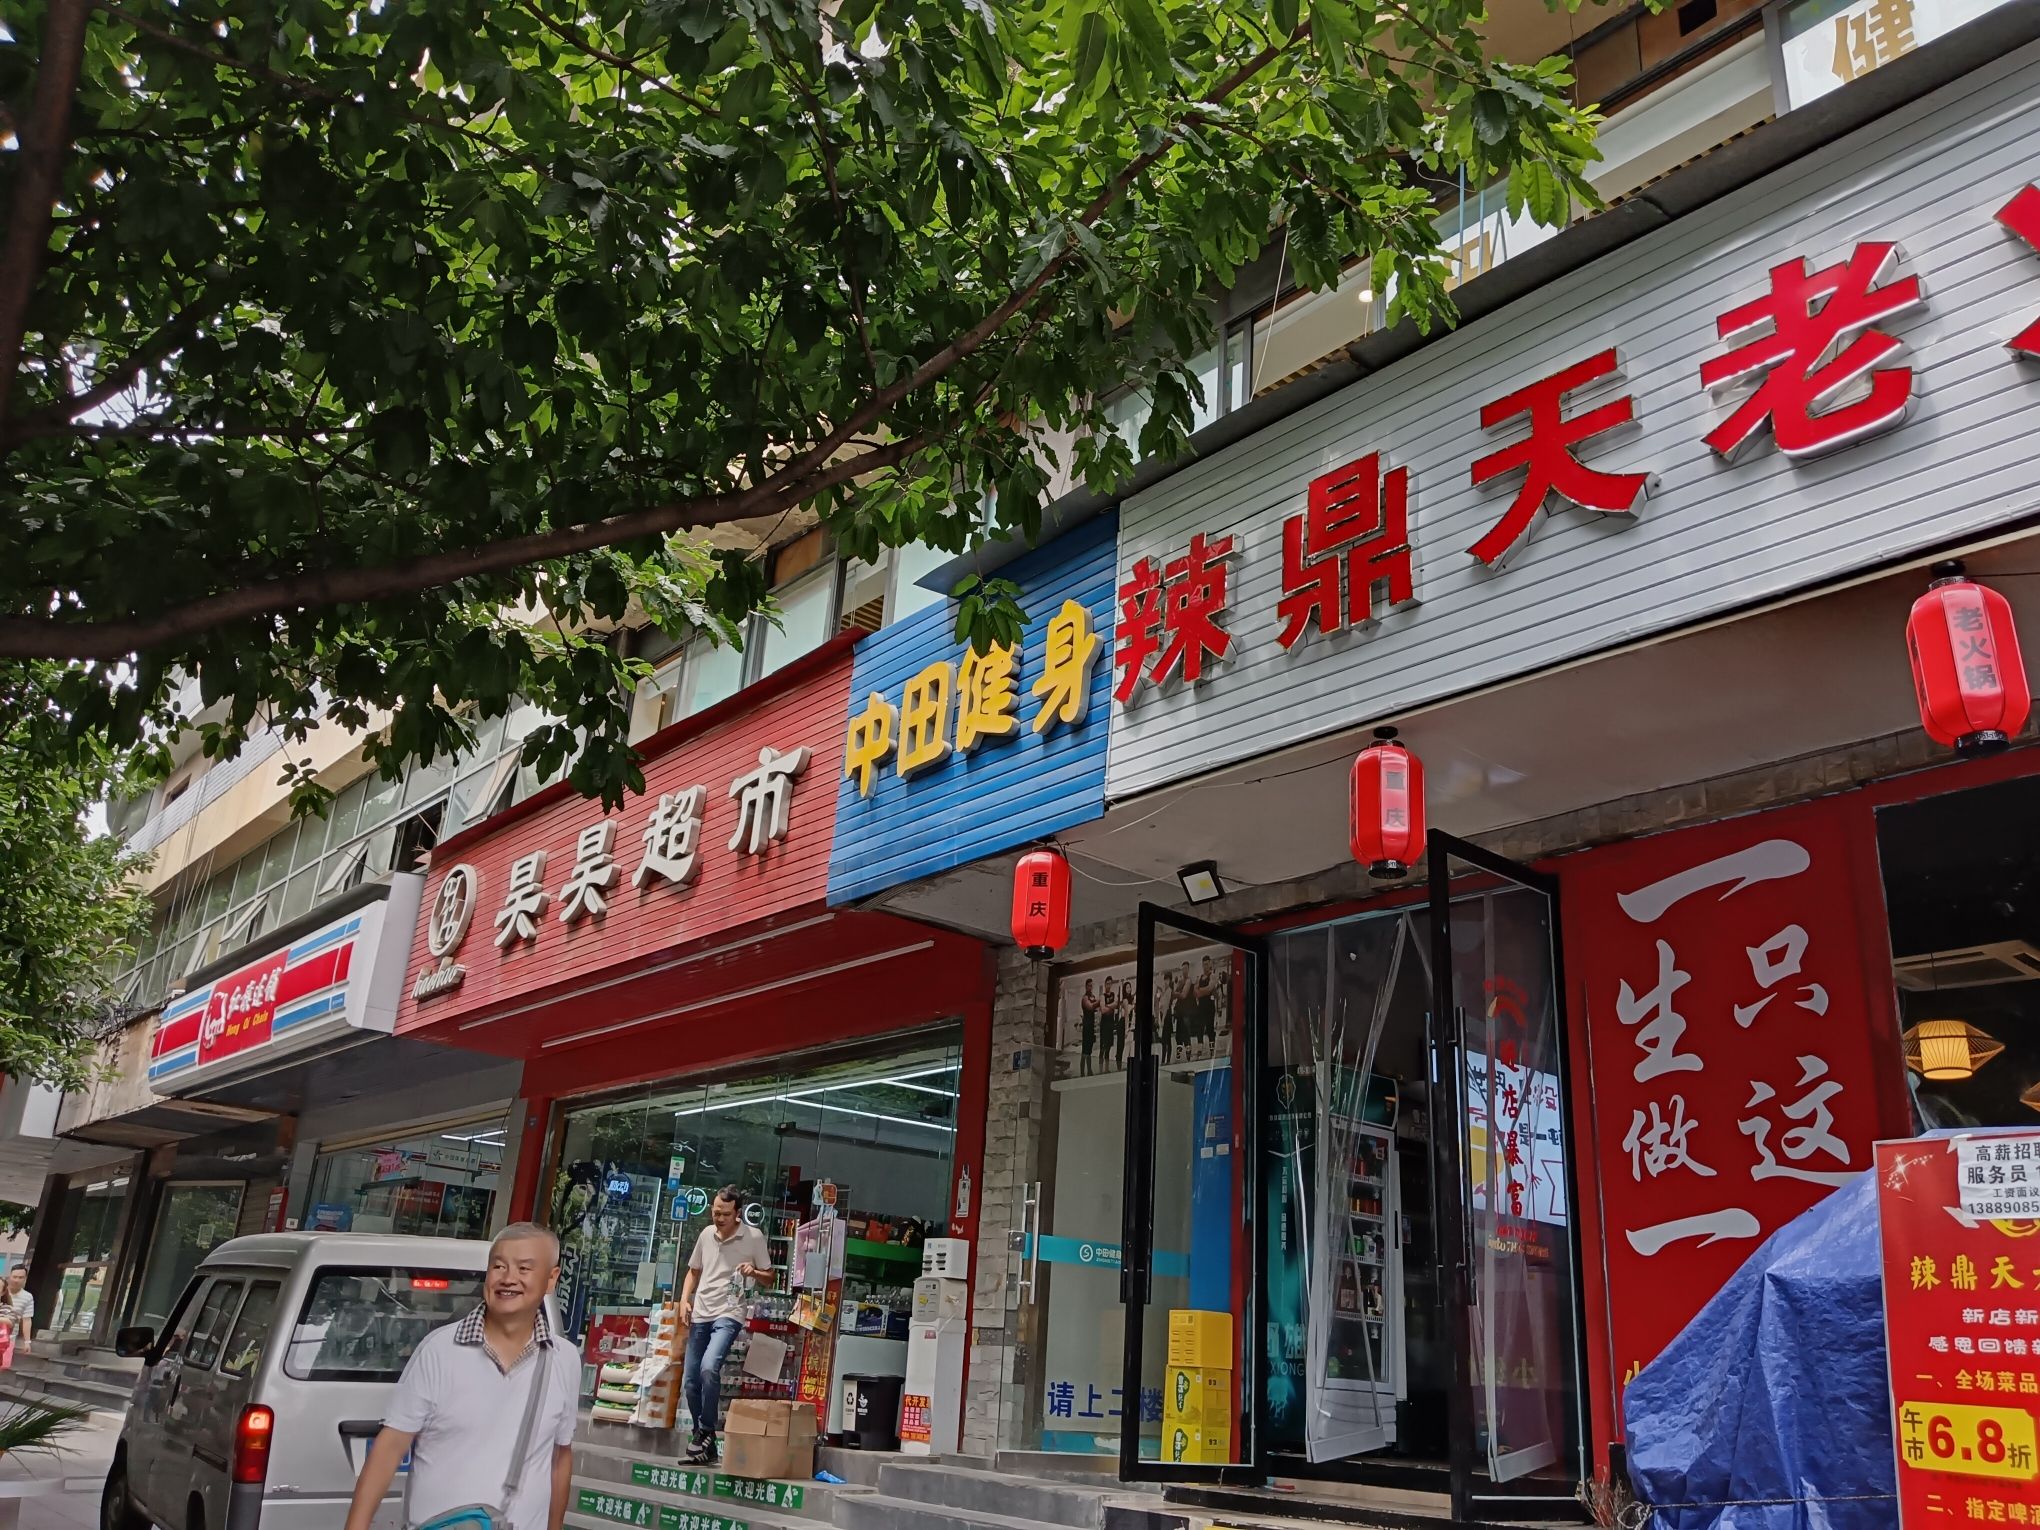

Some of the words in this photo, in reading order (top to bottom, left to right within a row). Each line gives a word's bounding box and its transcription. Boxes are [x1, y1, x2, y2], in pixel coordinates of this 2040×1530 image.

[1113, 183, 2040, 703] 辣鼎天老
[1953, 606, 1999, 690] 老火锅
[844, 597, 1105, 800] 中田健身
[493, 745, 813, 949] 昊昊超市
[1029, 871, 1049, 917] 重庆
[1967, 1165, 2027, 1184] 服务员
[1992, 1187, 2040, 1198] 工资面议
[905, 1396, 929, 1408] 代开发
[1903, 1408, 1925, 1461] 午市
[650, 1468, 688, 1491] 欢迎光临
[733, 1479, 777, 1504] 欢迎光临
[595, 1496, 632, 1520] 欢迎光临
